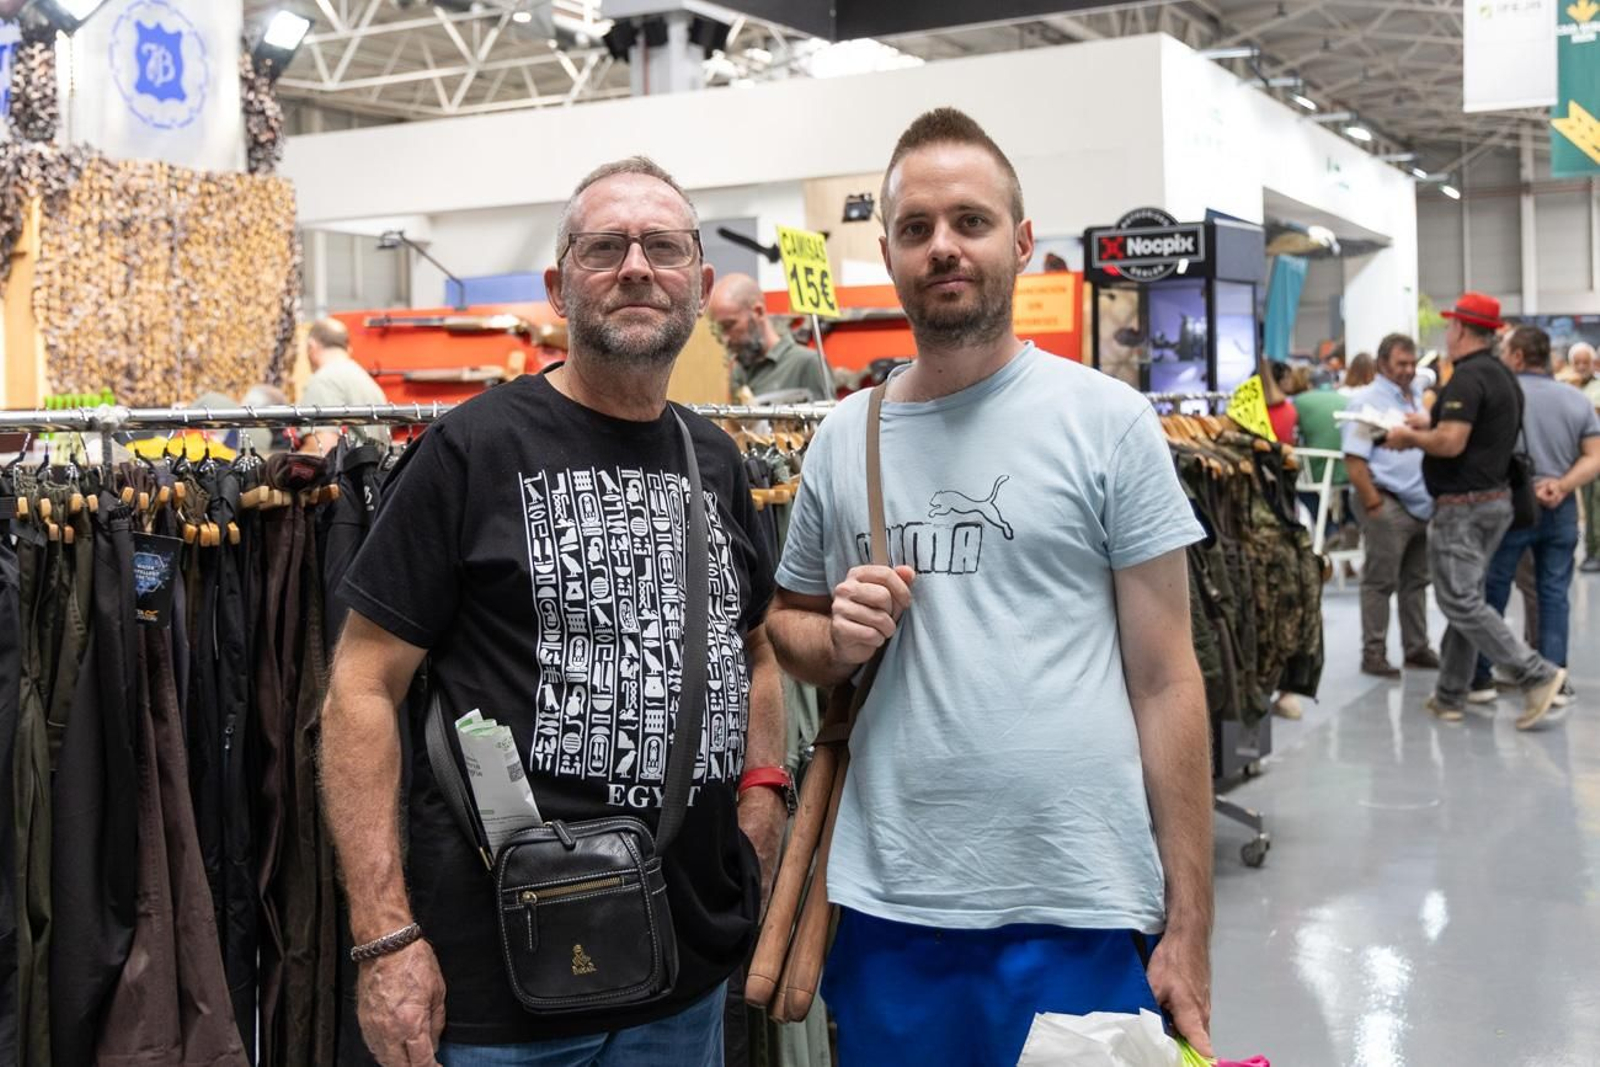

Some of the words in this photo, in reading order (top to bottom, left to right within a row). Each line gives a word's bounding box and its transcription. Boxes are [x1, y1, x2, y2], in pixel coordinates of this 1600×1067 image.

[781, 231, 827, 263] CAMISAS
[1126, 233, 1195, 257] Nocpix
[790, 263, 836, 311] 15€
[605, 783, 701, 808] EGYT
